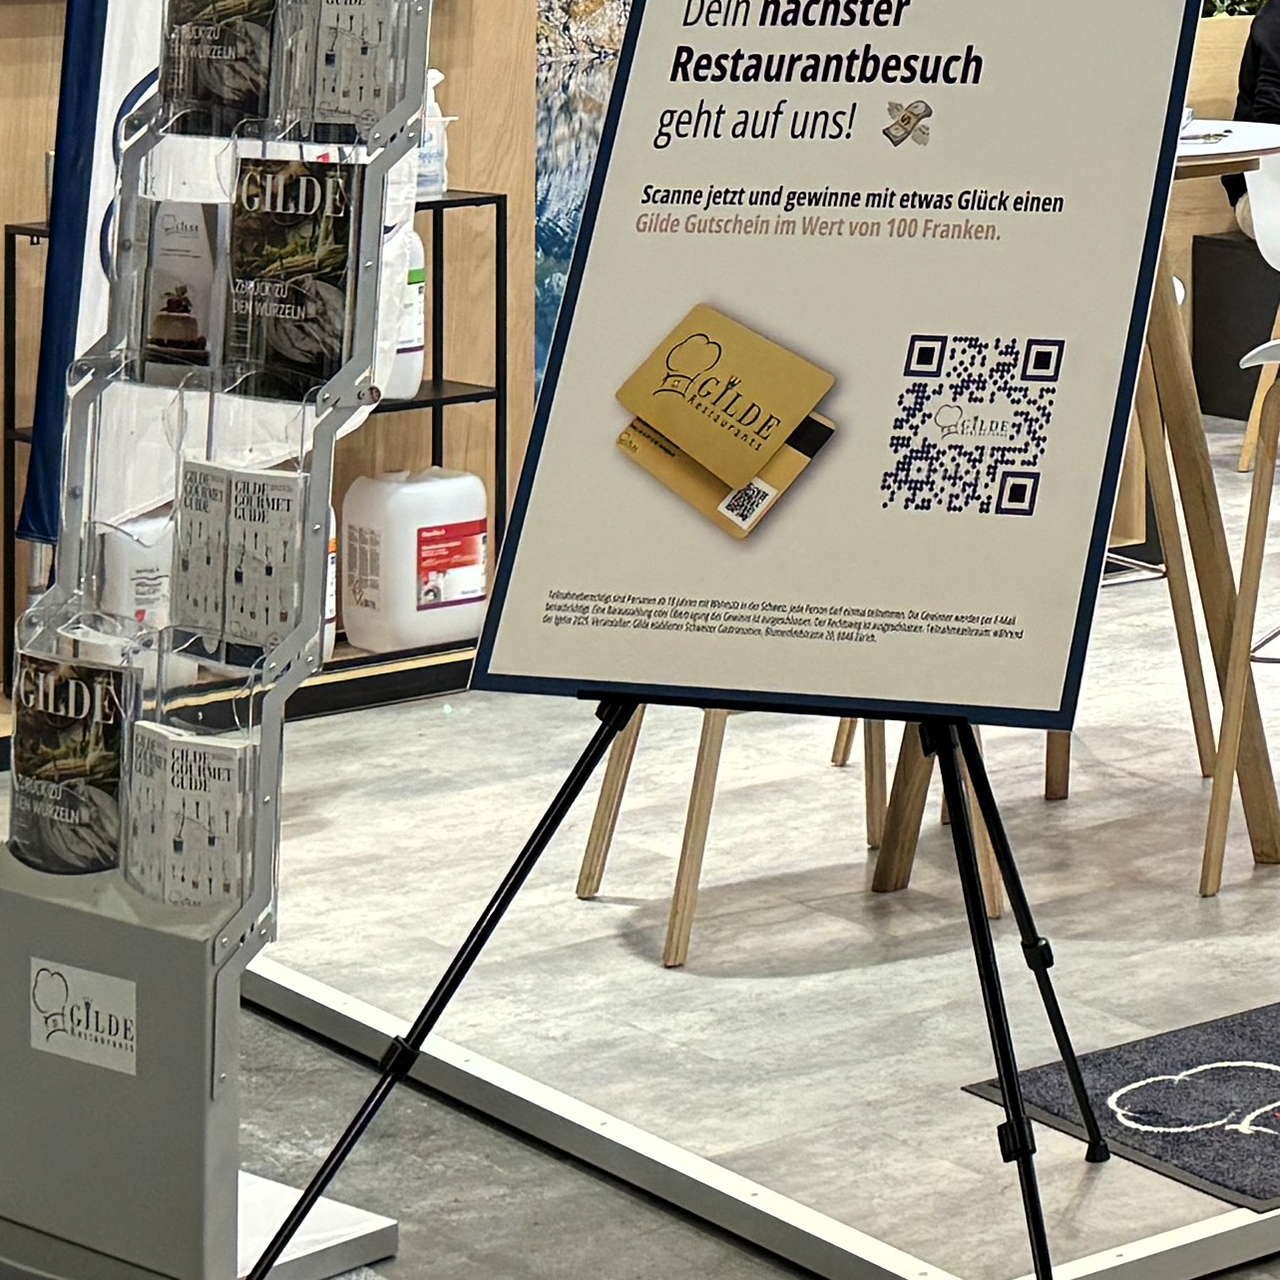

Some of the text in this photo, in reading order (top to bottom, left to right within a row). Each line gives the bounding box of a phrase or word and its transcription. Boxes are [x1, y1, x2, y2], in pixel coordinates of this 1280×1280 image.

[669, 43, 984, 84] Restaurantbesuch
[652, 99, 858, 149] geht auf uns!
[241, 171, 345, 217] GILDE
[641, 184, 1064, 212] Scanne jetzt und gewinne mit etwas Glück einen
[636, 213, 1001, 241] Gilde Gutschein im Wert von 100 Franken.
[697, 375, 782, 440] GILDE
[20, 668, 116, 724] GILDE
[70, 1001, 134, 1042] GILDE
